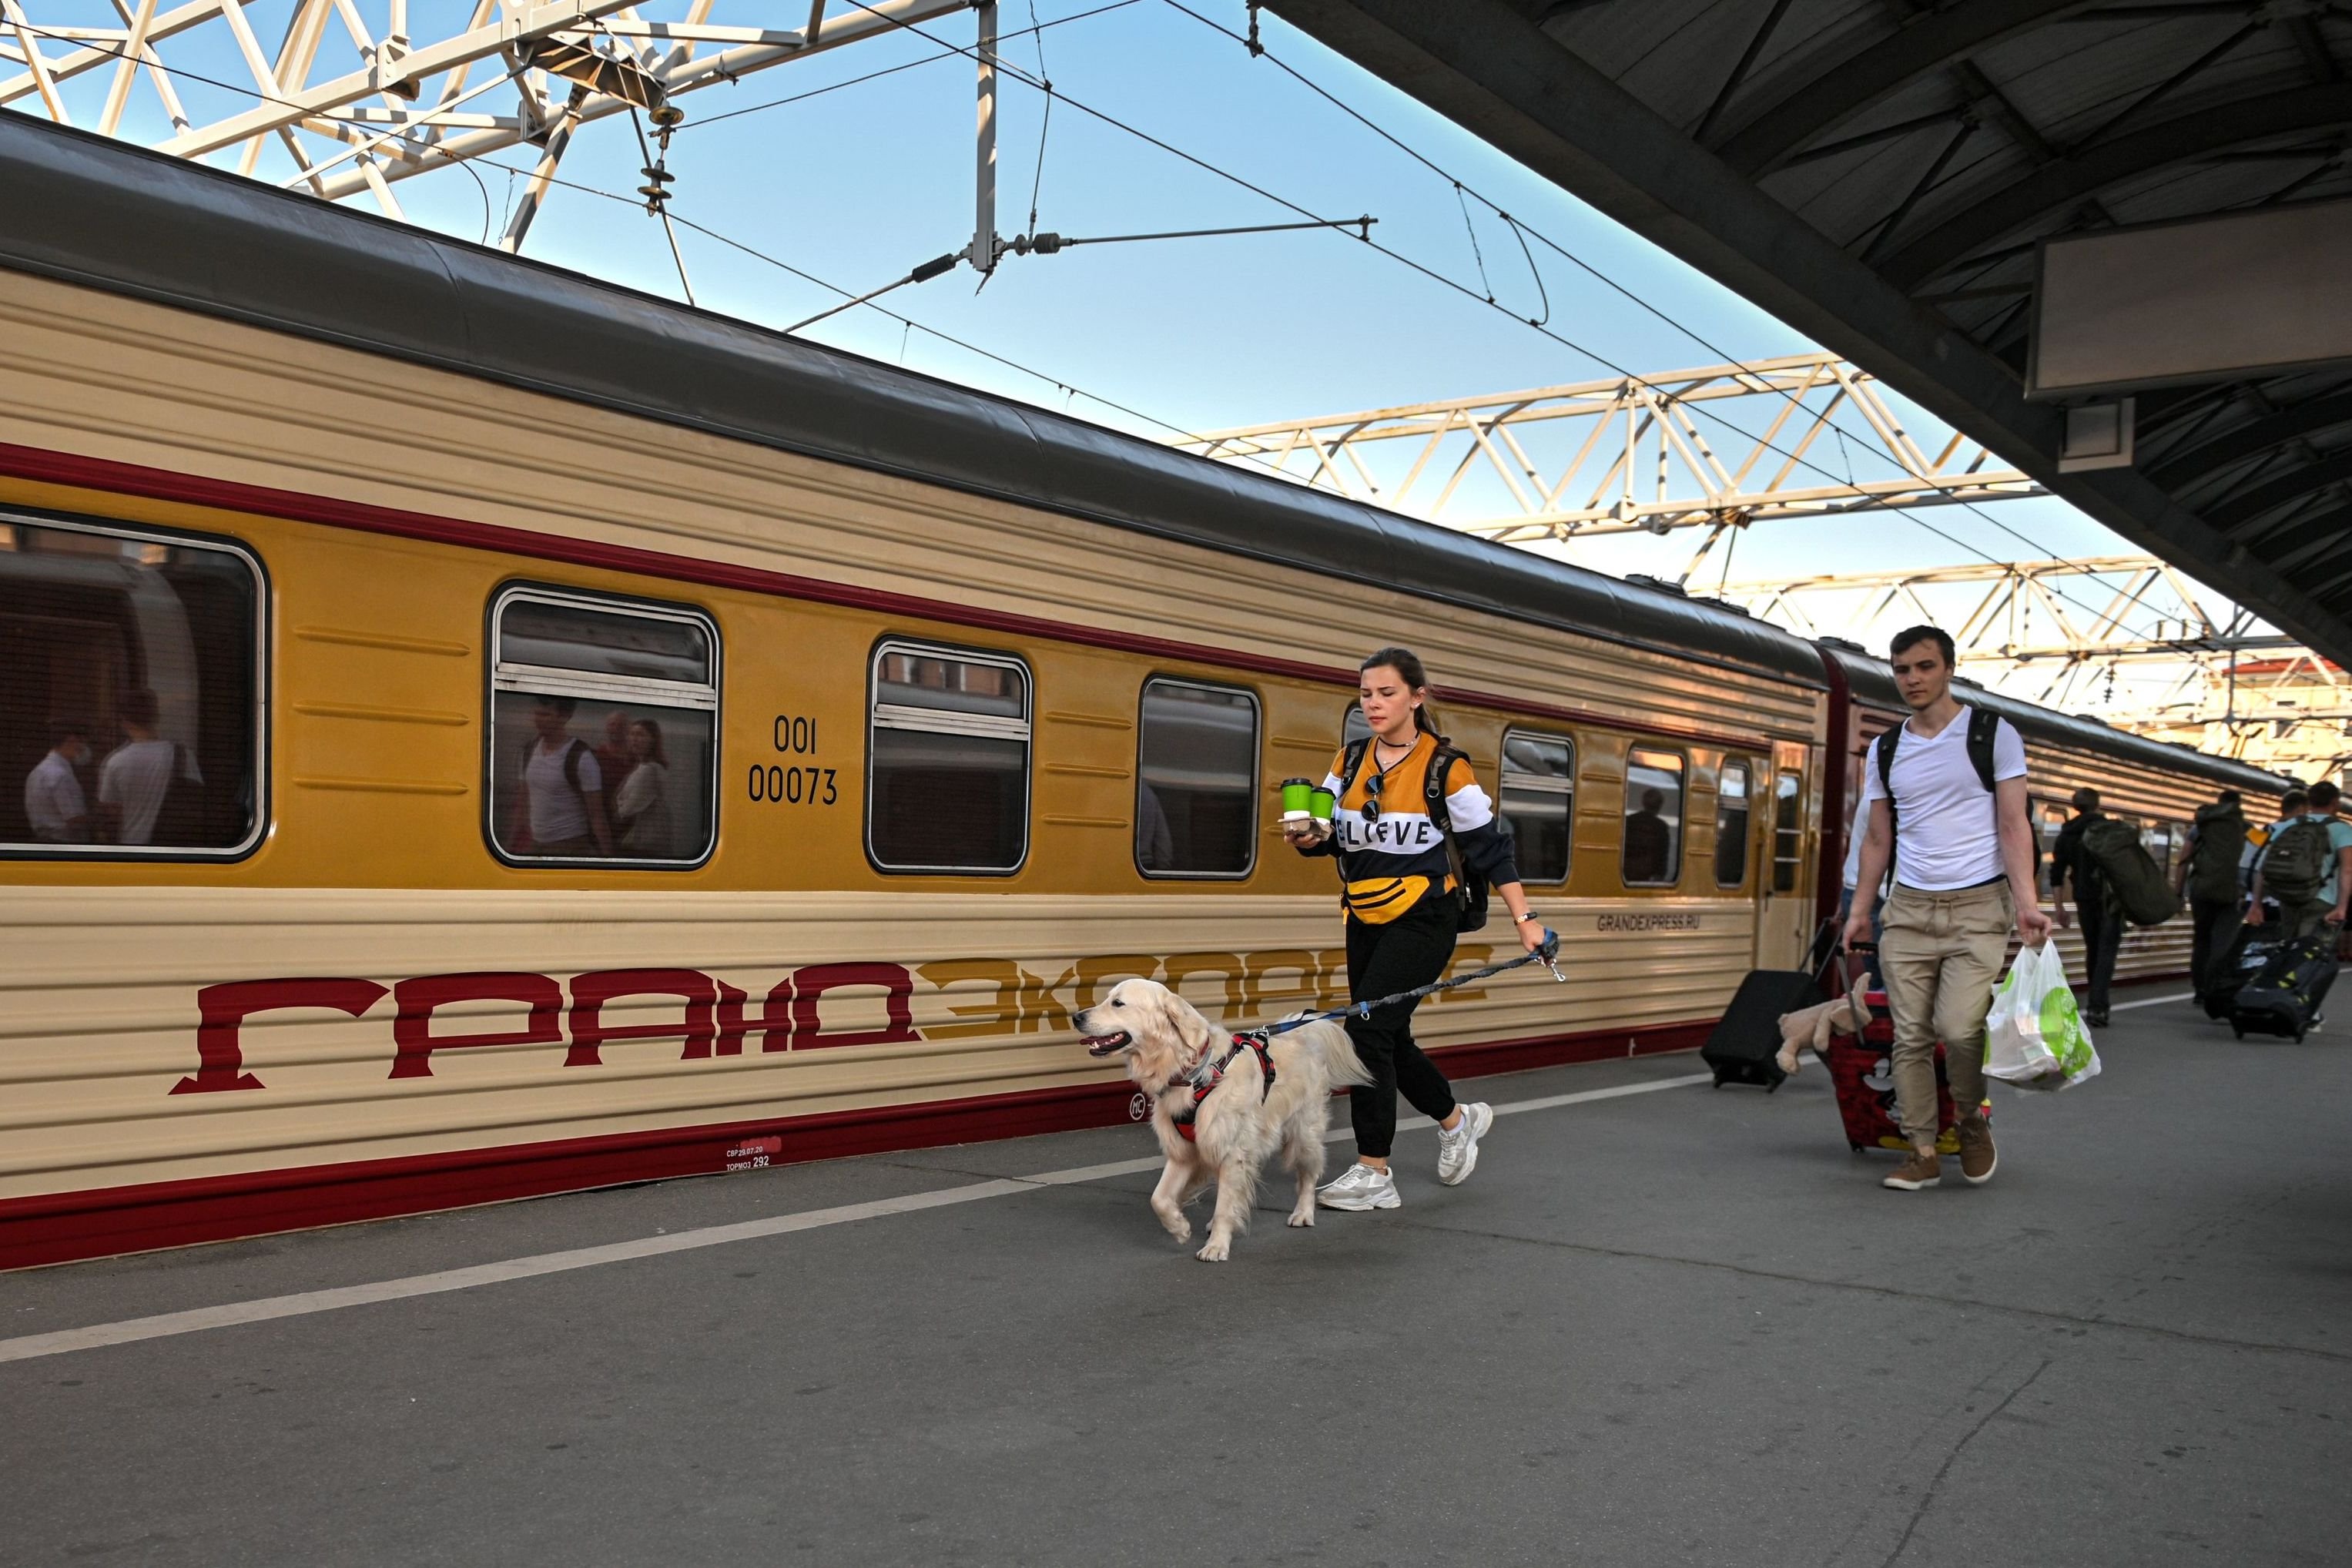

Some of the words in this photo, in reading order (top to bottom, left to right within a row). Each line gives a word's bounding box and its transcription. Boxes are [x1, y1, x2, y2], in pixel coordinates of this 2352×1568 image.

[774, 715, 816, 754] 001
[749, 764, 837, 805] 00073
[1597, 913, 1700, 932] GRANDEXPRESS.RU
[752, 1155, 769, 1168] 292
